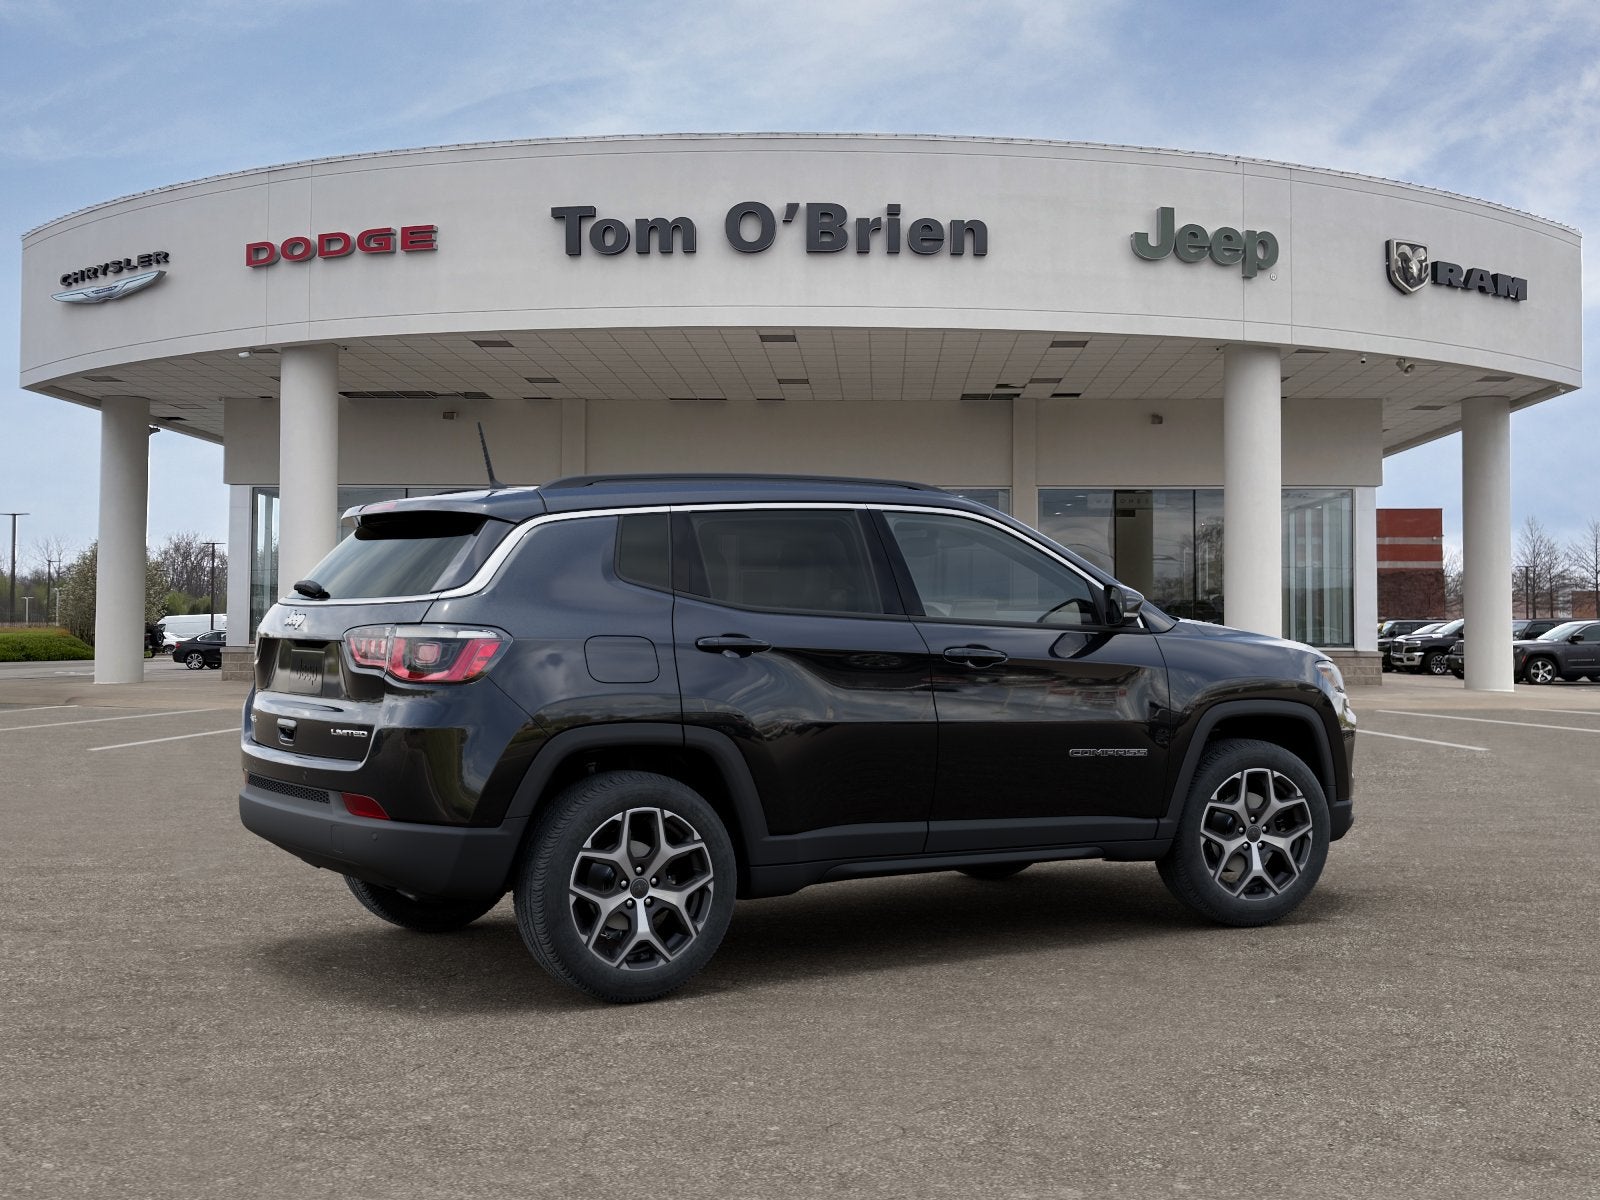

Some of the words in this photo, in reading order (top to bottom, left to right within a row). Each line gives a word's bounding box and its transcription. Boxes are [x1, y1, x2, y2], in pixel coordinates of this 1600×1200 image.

[246, 225, 438, 268] DODGE
[551, 205, 697, 256] Tom
[725, 201, 988, 256] O'Brien
[1131, 207, 1279, 278] Jeep
[60, 251, 170, 287] CHRYSLER
[1431, 260, 1528, 301] RAM
[330, 728, 368, 738] LIMITED
[1069, 748, 1148, 757] COMPASS
